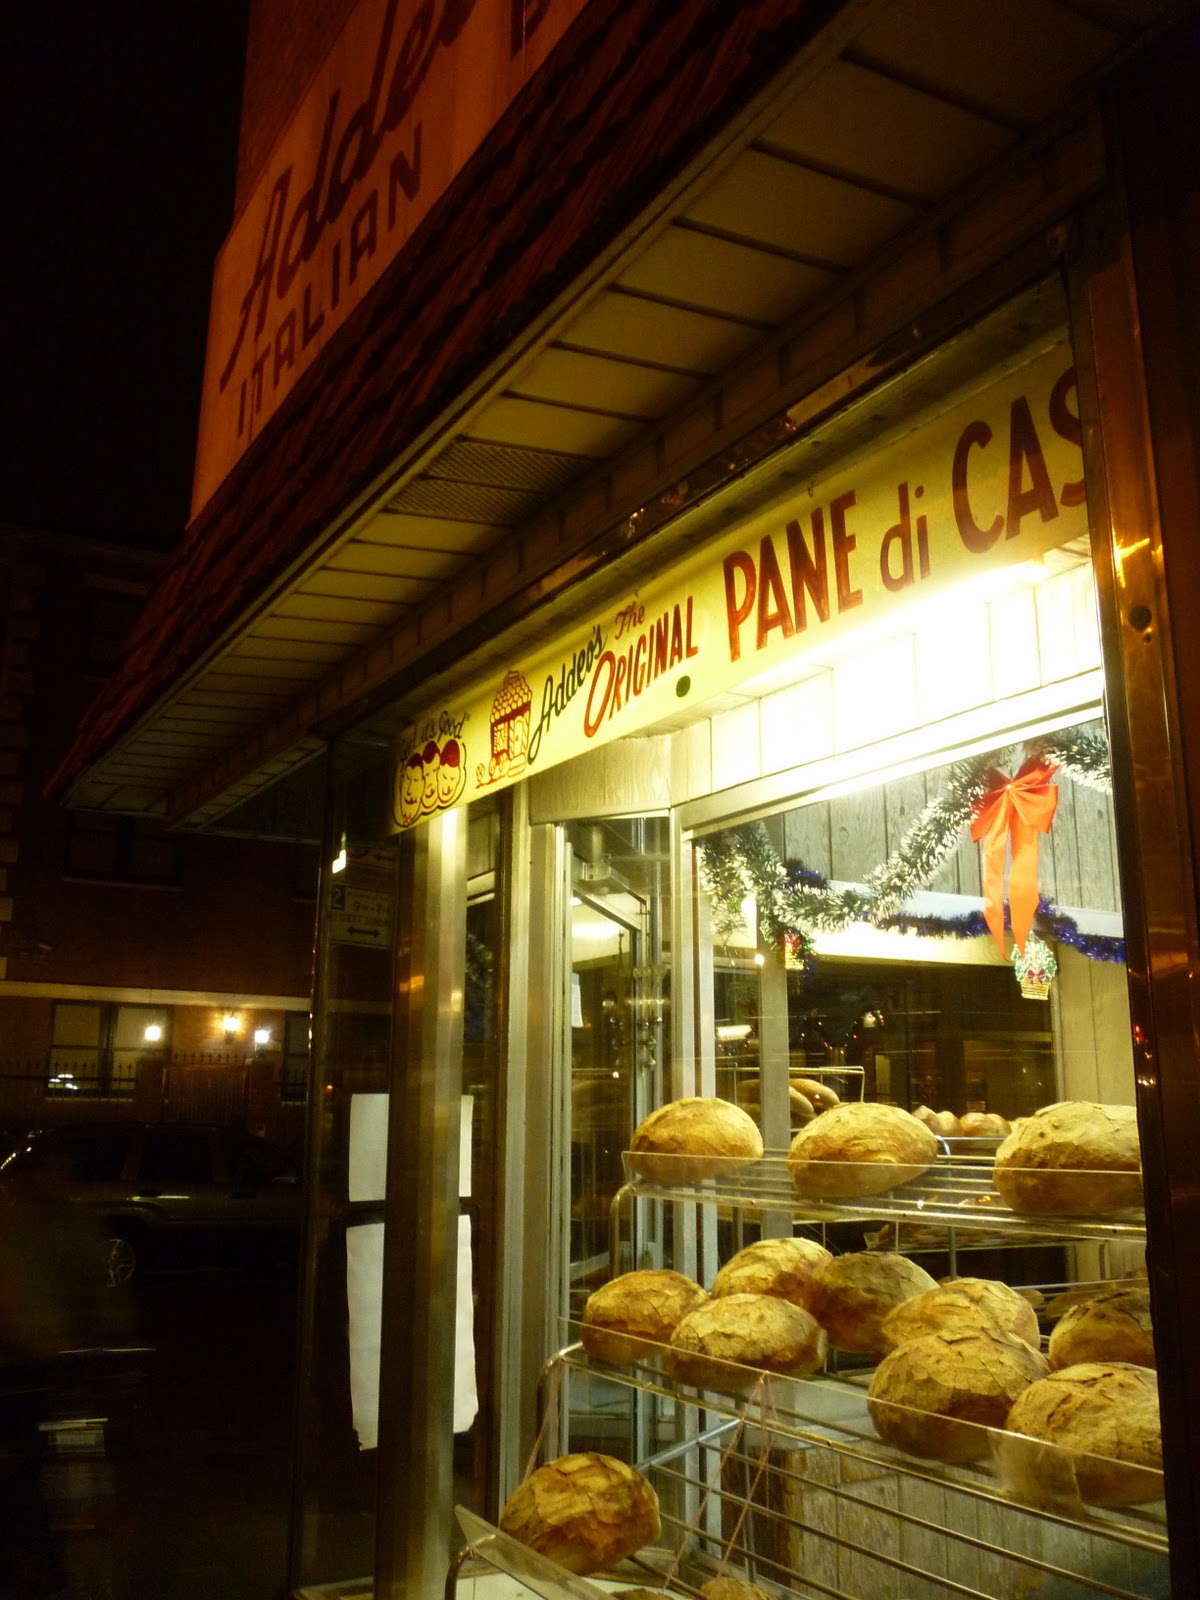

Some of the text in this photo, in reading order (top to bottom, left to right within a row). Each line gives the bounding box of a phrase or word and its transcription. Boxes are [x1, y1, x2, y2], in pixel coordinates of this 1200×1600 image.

[237, 121, 422, 436] ITALIAN
[527, 624, 609, 766] Addeo's
[583, 596, 699, 738] ORIGINAL
[723, 489, 863, 662] PANE
[880, 481, 930, 592] di
[614, 600, 646, 640] The
